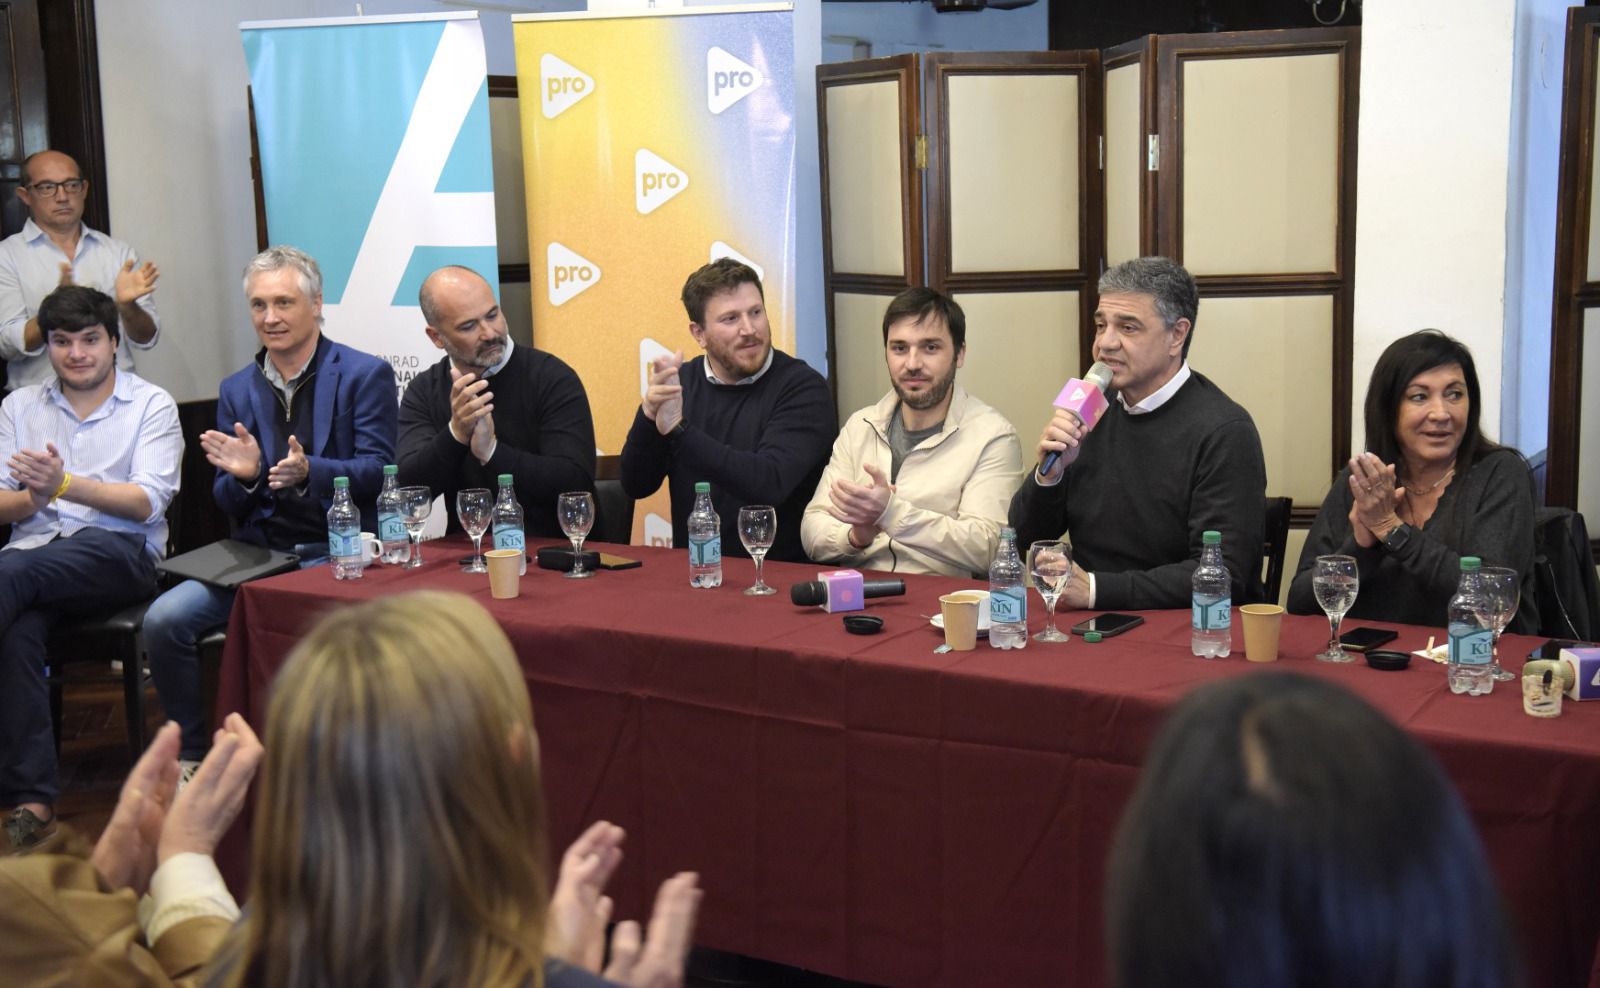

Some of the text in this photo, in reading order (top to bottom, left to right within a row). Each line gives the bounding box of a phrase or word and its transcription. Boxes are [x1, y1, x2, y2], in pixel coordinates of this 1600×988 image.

[547, 76, 586, 102] pro
[714, 71, 754, 97] pro
[642, 172, 680, 197] pro
[554, 265, 593, 290] pro
[501, 536, 522, 547] KIN
